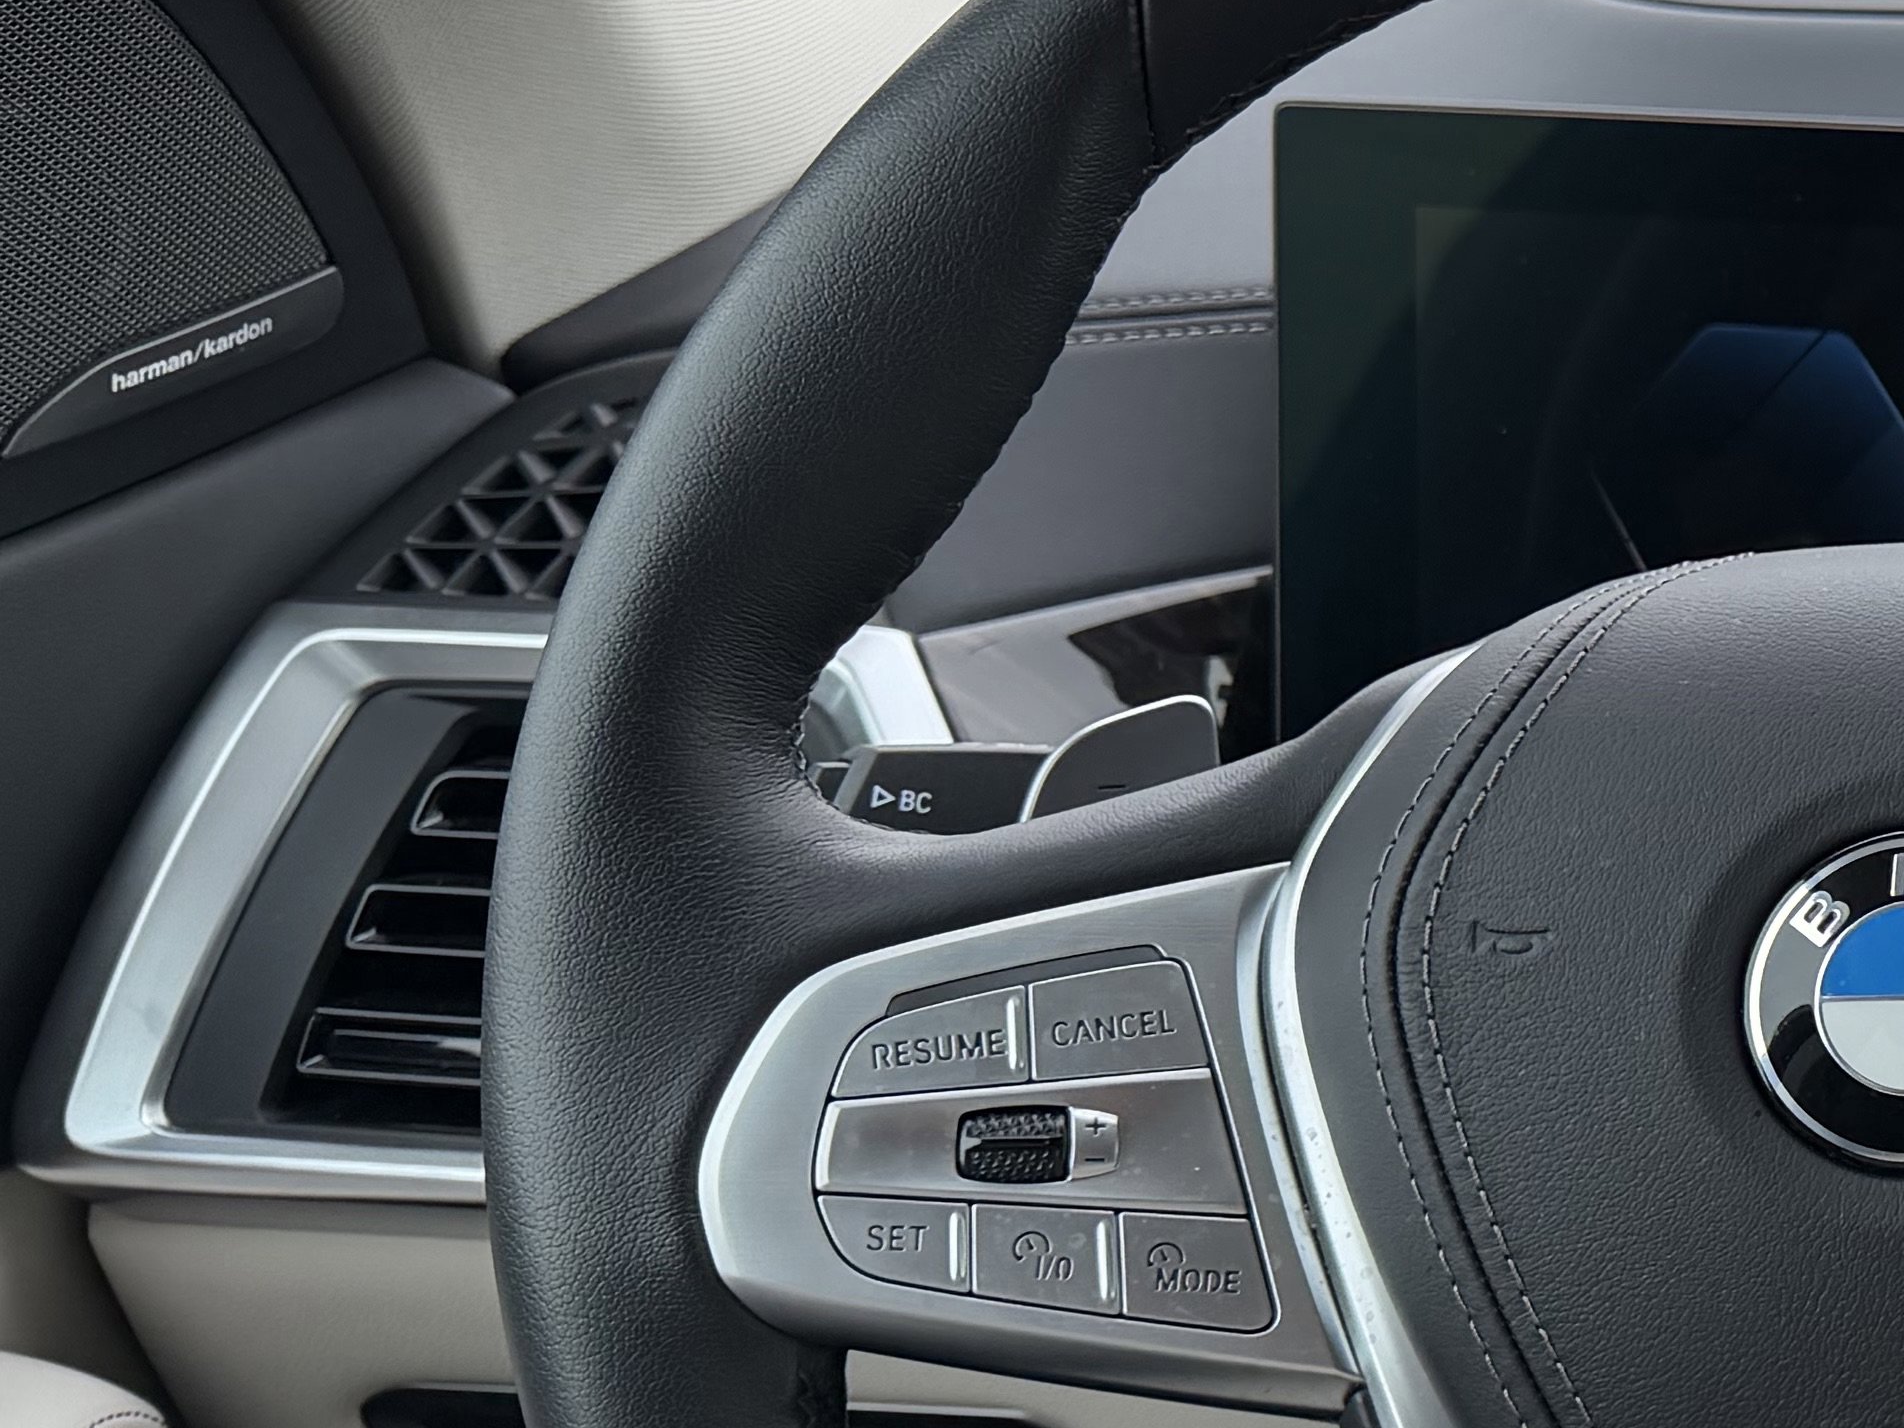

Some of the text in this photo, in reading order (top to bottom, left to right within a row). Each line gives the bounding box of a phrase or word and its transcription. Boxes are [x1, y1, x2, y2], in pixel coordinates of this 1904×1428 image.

[111, 316, 273, 392] harman/kardon
[899, 788, 933, 814] BC
[1050, 1009, 1176, 1048] CANCEL
[871, 1028, 1007, 1070] RESUME
[866, 1225, 929, 1252] SET
[1153, 1266, 1241, 1294] MODE
